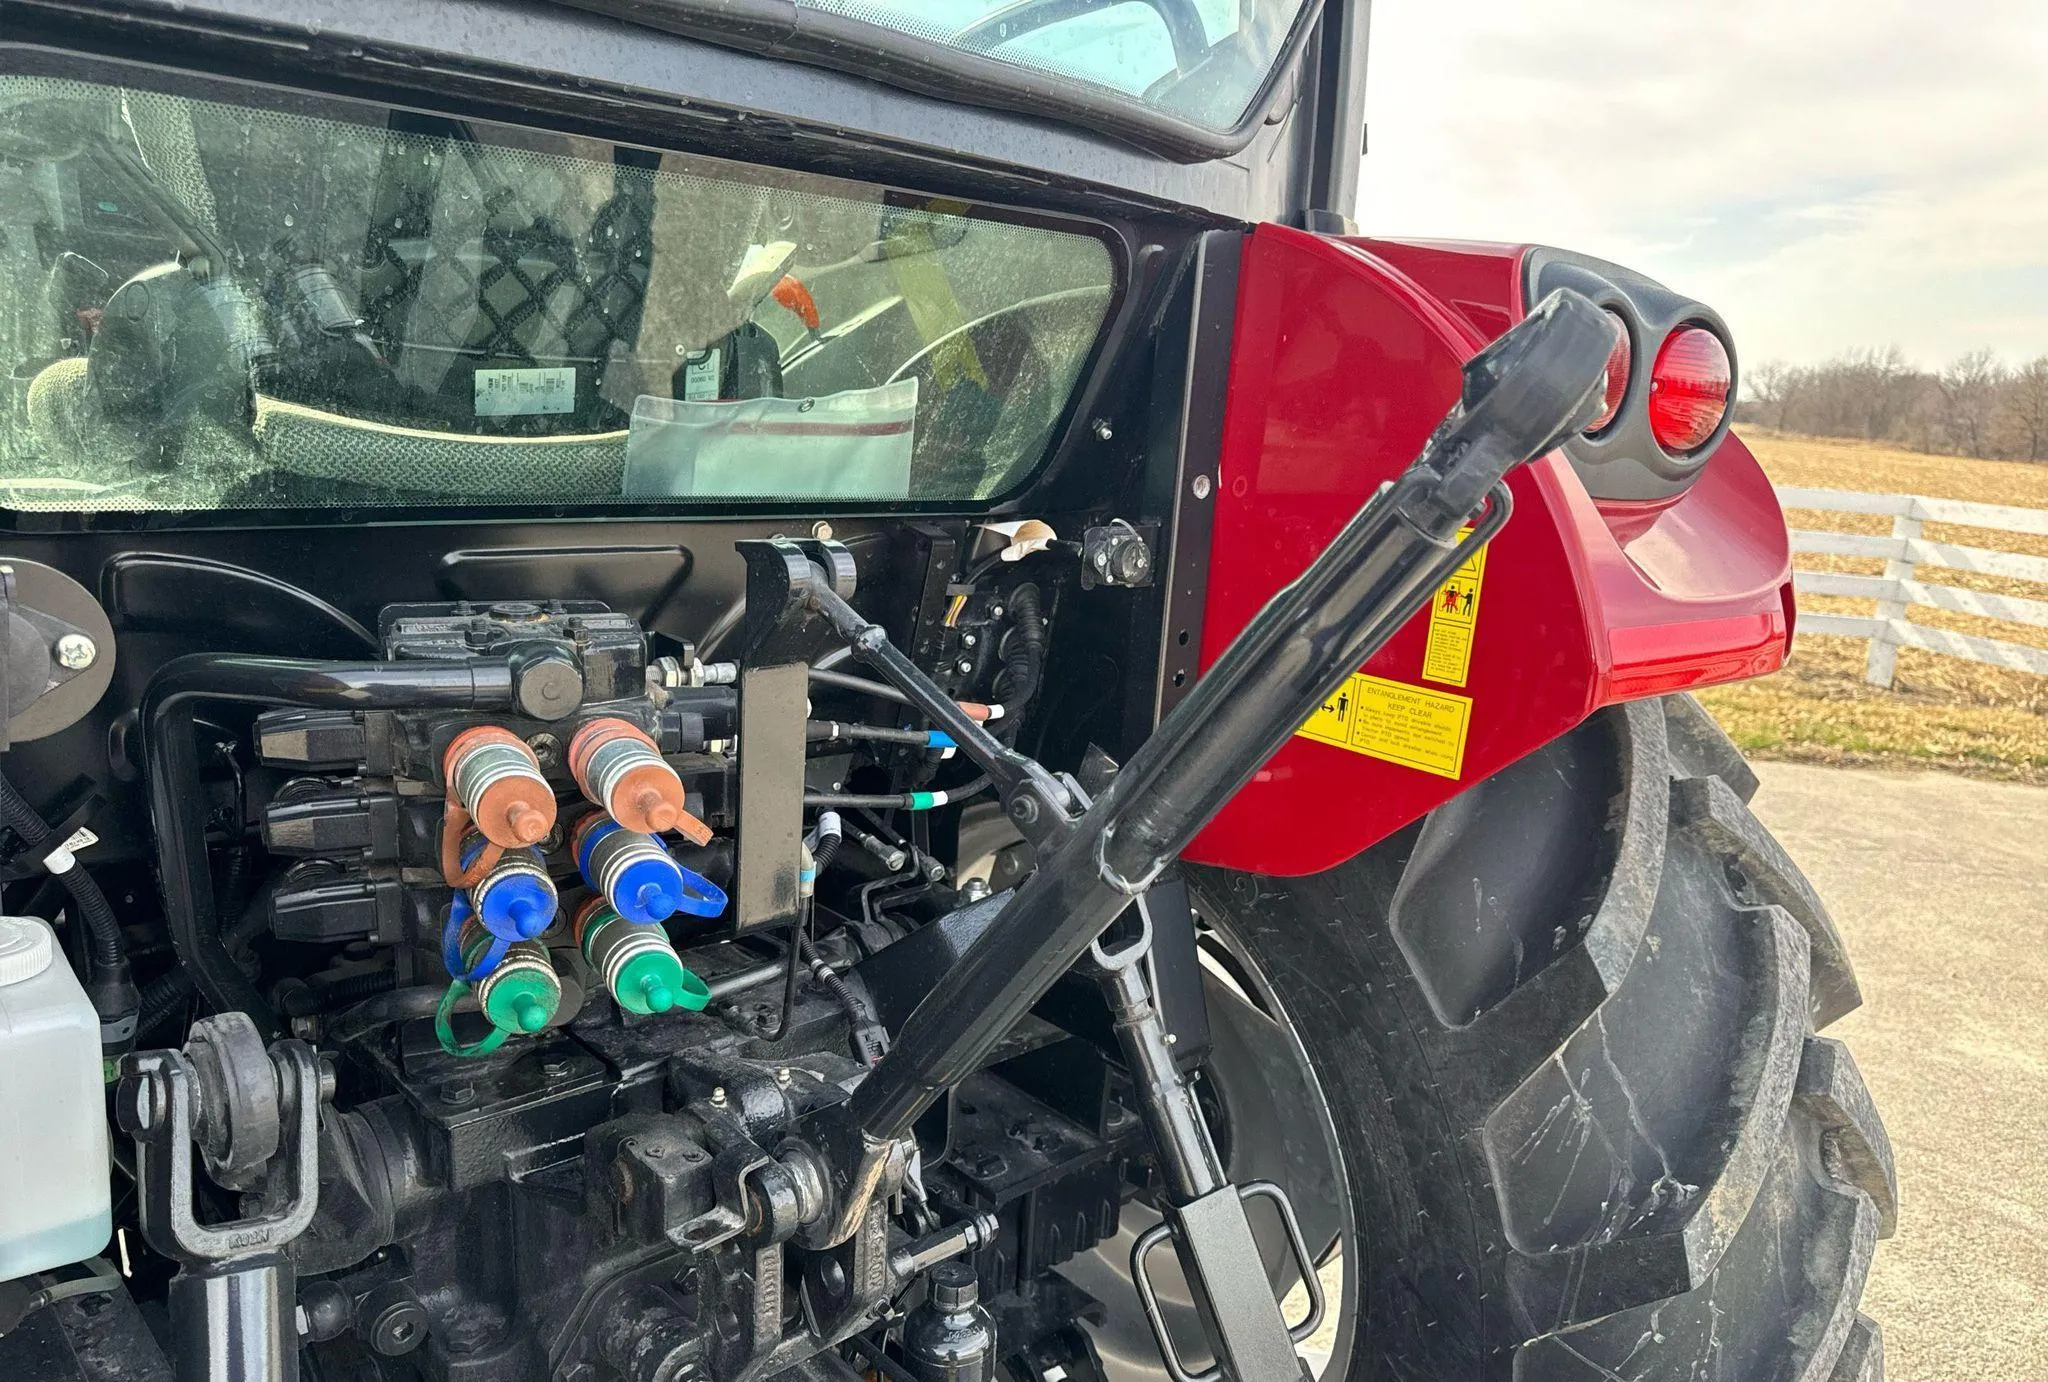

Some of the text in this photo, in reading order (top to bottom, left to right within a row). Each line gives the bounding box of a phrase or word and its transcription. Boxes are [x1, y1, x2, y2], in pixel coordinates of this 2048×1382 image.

[1367, 687, 1455, 713] ENTANGLEMENT HAZARD
[1388, 702, 1432, 718] KEEP CLEAR
